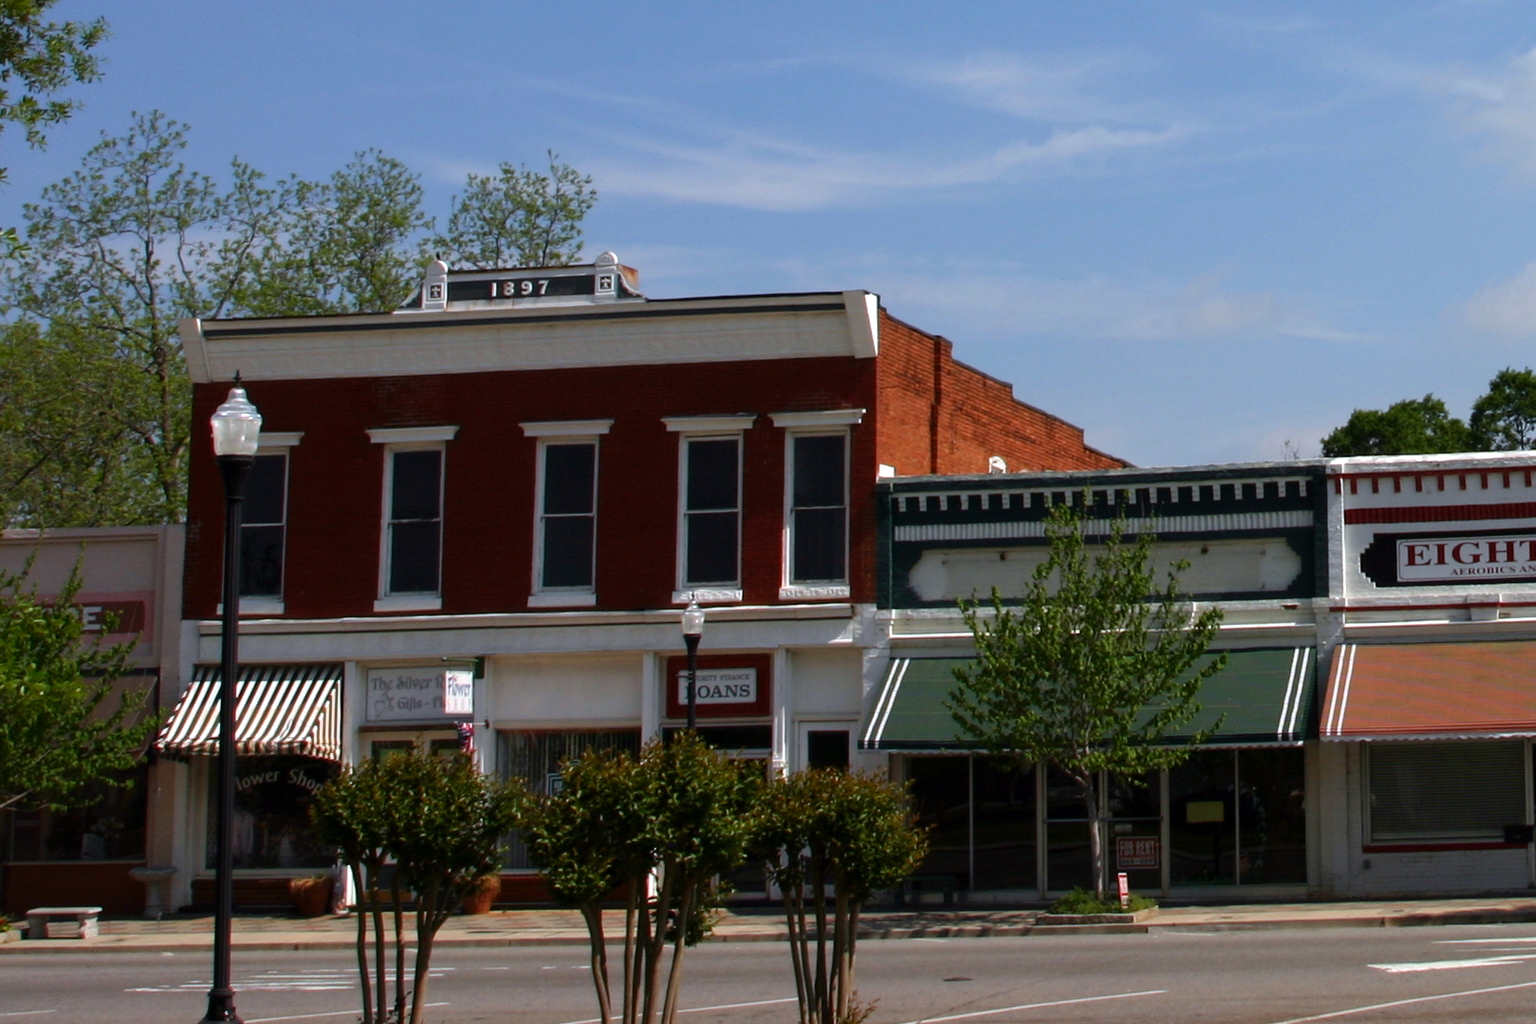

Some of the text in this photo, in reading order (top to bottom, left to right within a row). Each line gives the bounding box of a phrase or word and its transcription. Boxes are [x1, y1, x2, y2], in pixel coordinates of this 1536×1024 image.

[490, 280, 549, 297] 1897
[1450, 566, 1516, 576] AEROBICS
[371, 677, 394, 691] The
[396, 676, 433, 691] Silver
[235, 768, 324, 795] lower Shop
